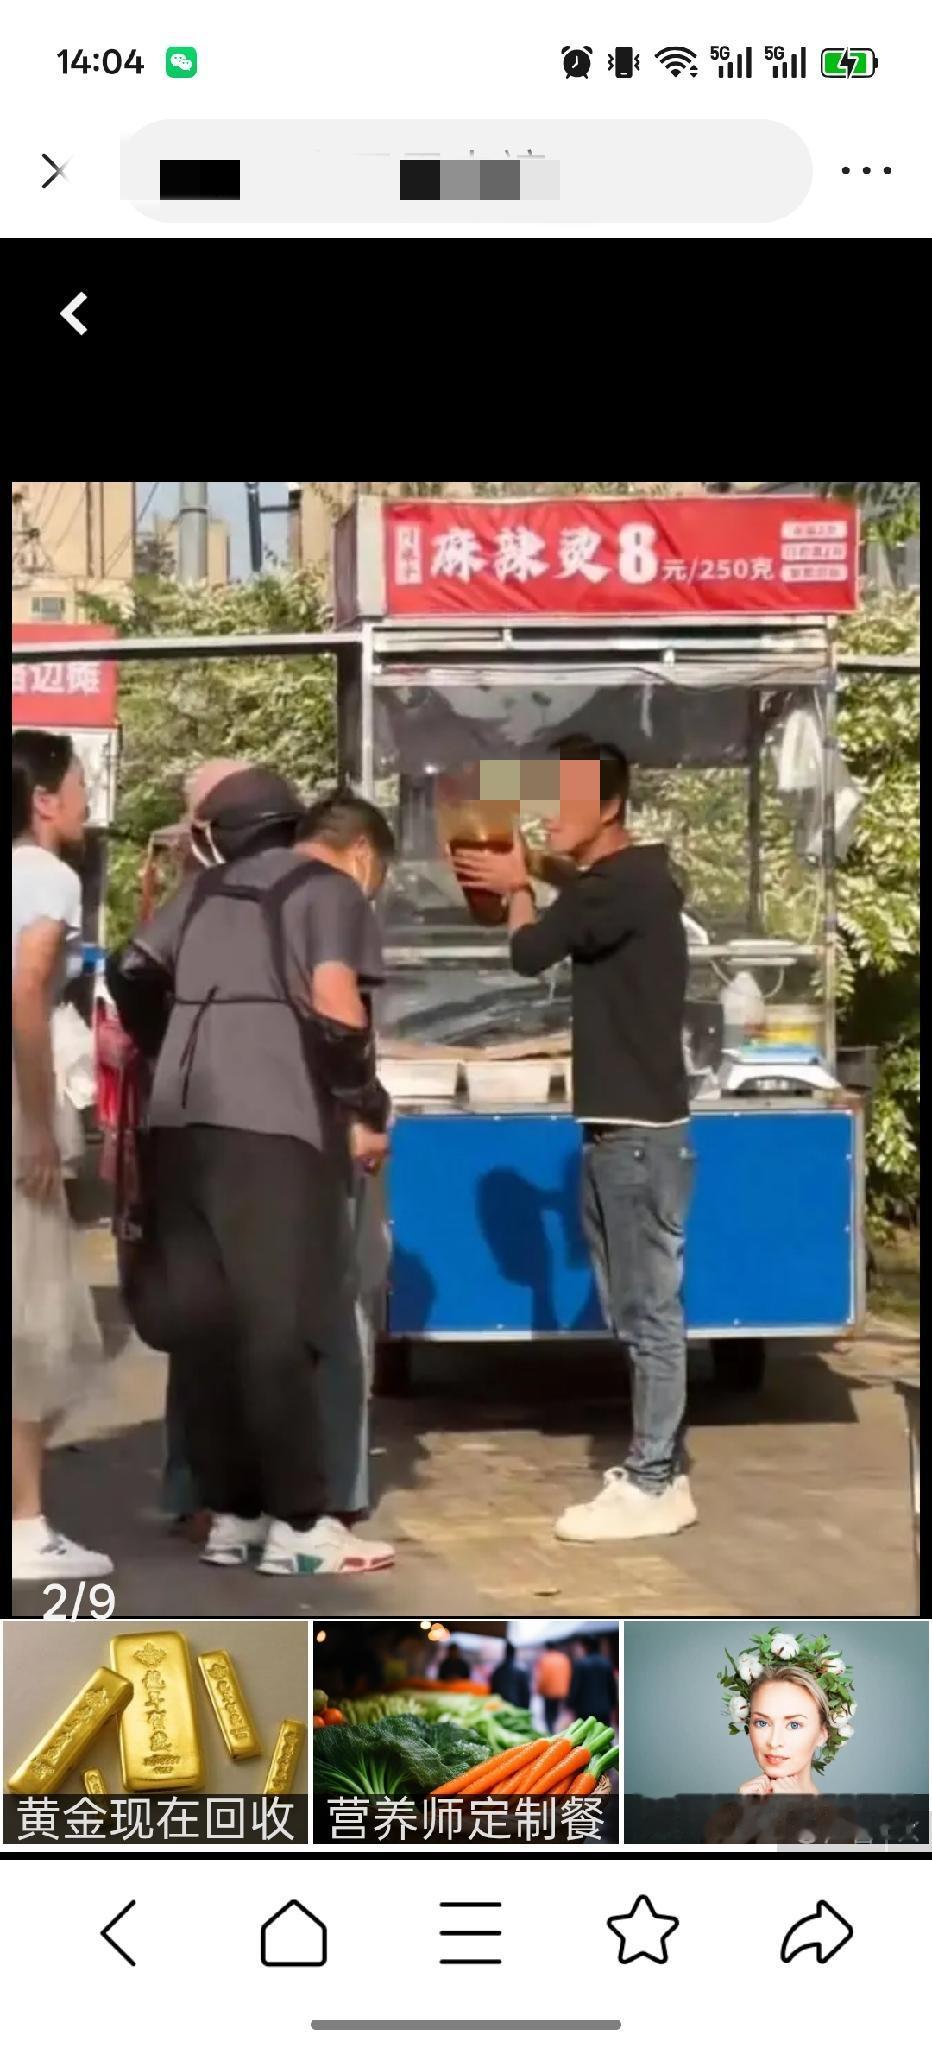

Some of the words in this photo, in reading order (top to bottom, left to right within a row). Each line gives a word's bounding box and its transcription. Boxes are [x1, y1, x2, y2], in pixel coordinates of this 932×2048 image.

[711, 46, 730, 60] 5G
[765, 46, 784, 60] 5G
[57, 49, 144, 74] 14:04
